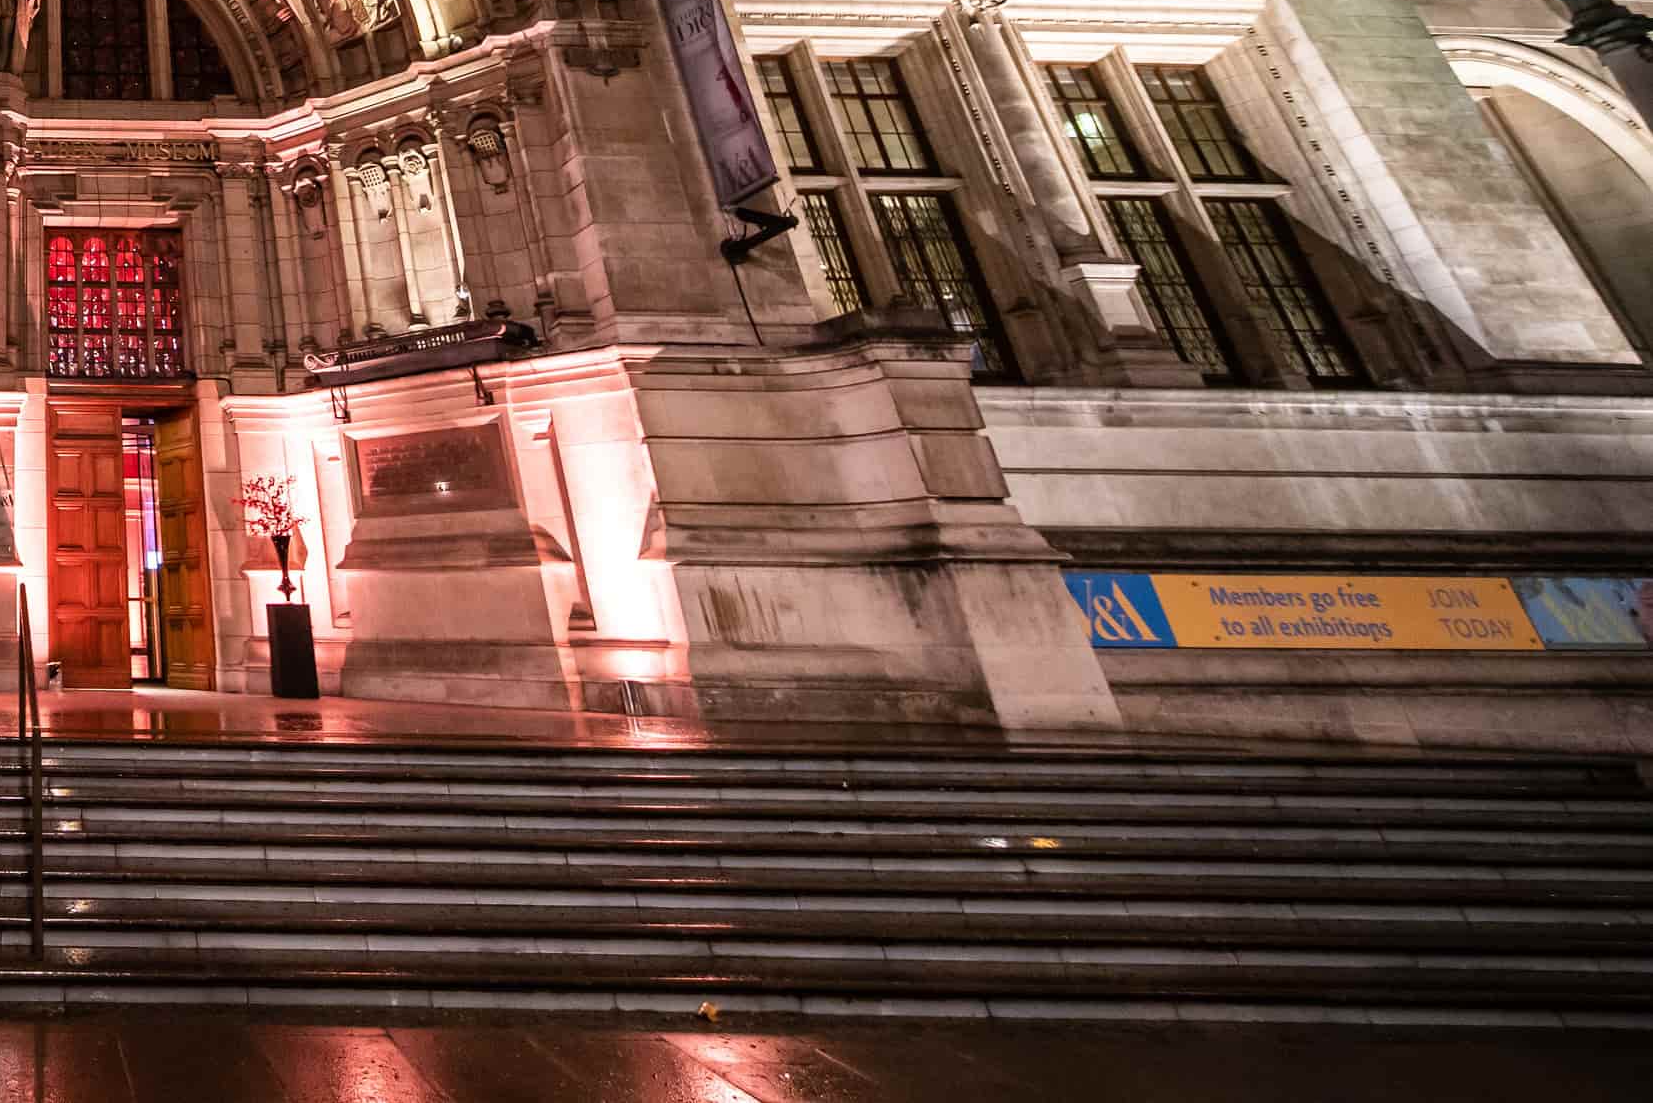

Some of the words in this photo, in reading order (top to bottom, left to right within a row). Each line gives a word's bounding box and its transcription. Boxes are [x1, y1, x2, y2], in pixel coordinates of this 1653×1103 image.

[32, 140, 106, 158] ABER
[124, 141, 217, 161] MUSEUM
[1209, 586, 1307, 608] Members
[1309, 592, 1336, 613] go
[1337, 586, 1382, 608] free
[1427, 588, 1481, 609] JOIN
[1221, 617, 1246, 636] to
[1250, 615, 1275, 636] all
[1278, 615, 1393, 640] exhibitions
[1437, 617, 1514, 640] TODAY
